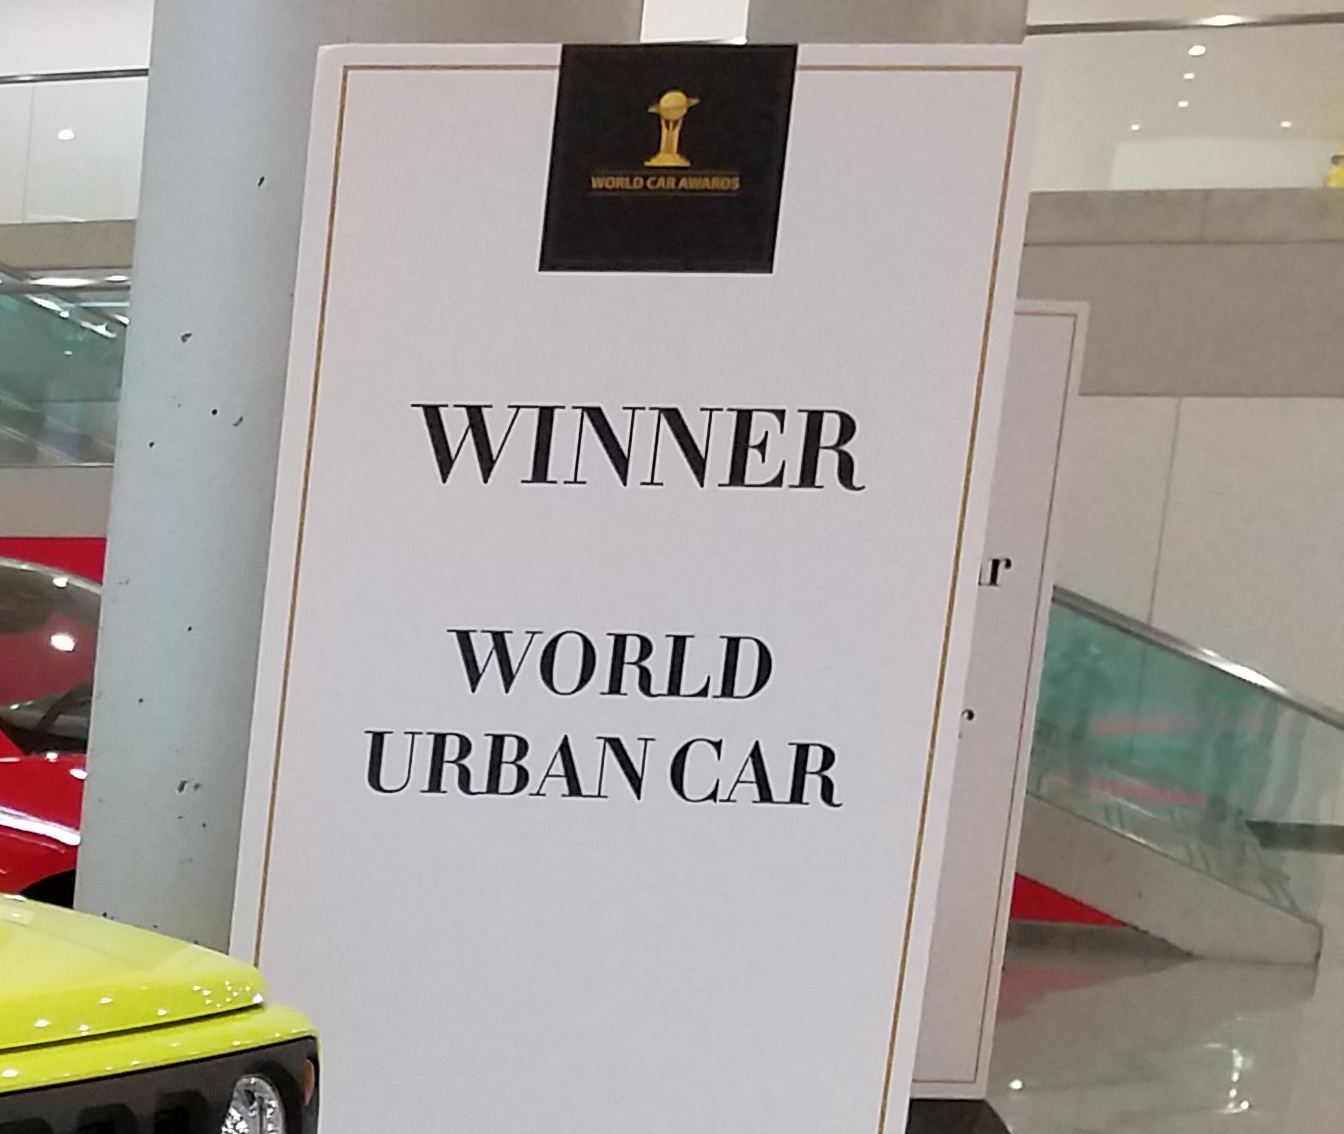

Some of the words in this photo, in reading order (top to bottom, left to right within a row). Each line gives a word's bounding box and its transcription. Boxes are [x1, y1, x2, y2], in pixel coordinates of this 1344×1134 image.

[591, 176, 644, 190] WORLD
[646, 176, 675, 190] CAR
[677, 176, 741, 191] AWARDS
[410, 403, 866, 492] WINNER
[446, 629, 774, 701] WORLD
[363, 730, 657, 801] URBAN
[668, 737, 844, 808] CAR
